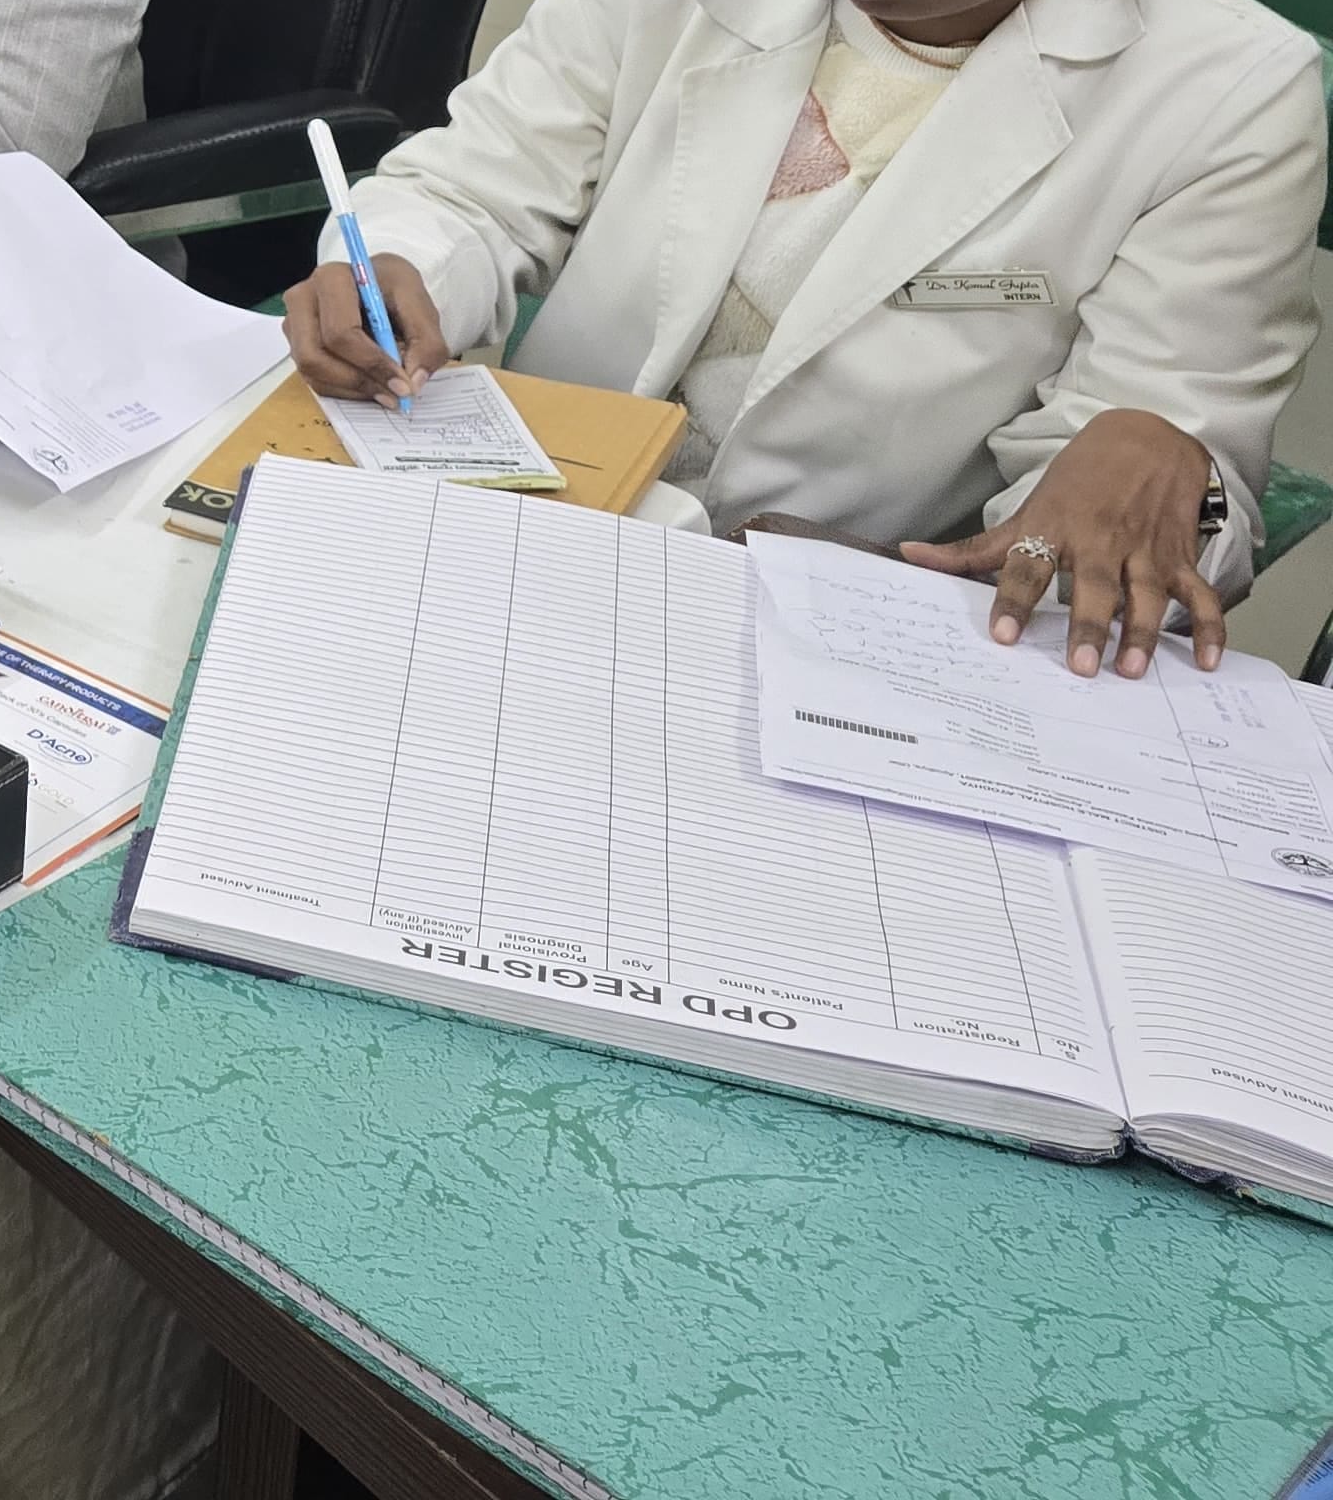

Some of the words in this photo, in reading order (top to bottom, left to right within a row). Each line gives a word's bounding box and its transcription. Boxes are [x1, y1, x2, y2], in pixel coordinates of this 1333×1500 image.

[1004, 293, 1041, 301] INTERN
[178, 484, 234, 509] OK
[21, 658, 68, 688] THERAPY
[65, 680, 123, 712] PRODUCTS
[26, 728, 87, 764] D'Acne
[200, 872, 253, 891] Advised
[257, 886, 322, 908] Treatment
[378, 907, 404, 921] any)
[404, 913, 421, 926] (if
[385, 919, 464, 942] Investigation
[422, 918, 473, 934] Advised
[498, 940, 587, 964] Provisional
[504, 932, 582, 953] Diagnosis
[401, 937, 663, 1006] REGISTER
[621, 959, 653, 972] Age
[719, 977, 766, 995] Name
[770, 988, 844, 1011] Patient's
[682, 994, 798, 1030] OPD
[914, 1020, 1021, 1048] Registration
[950, 1019, 979, 1031] No.
[1050, 1036, 1080, 1054] No.
[1057, 1049, 1078, 1062] S.
[1211, 1066, 1278, 1094] Advised
